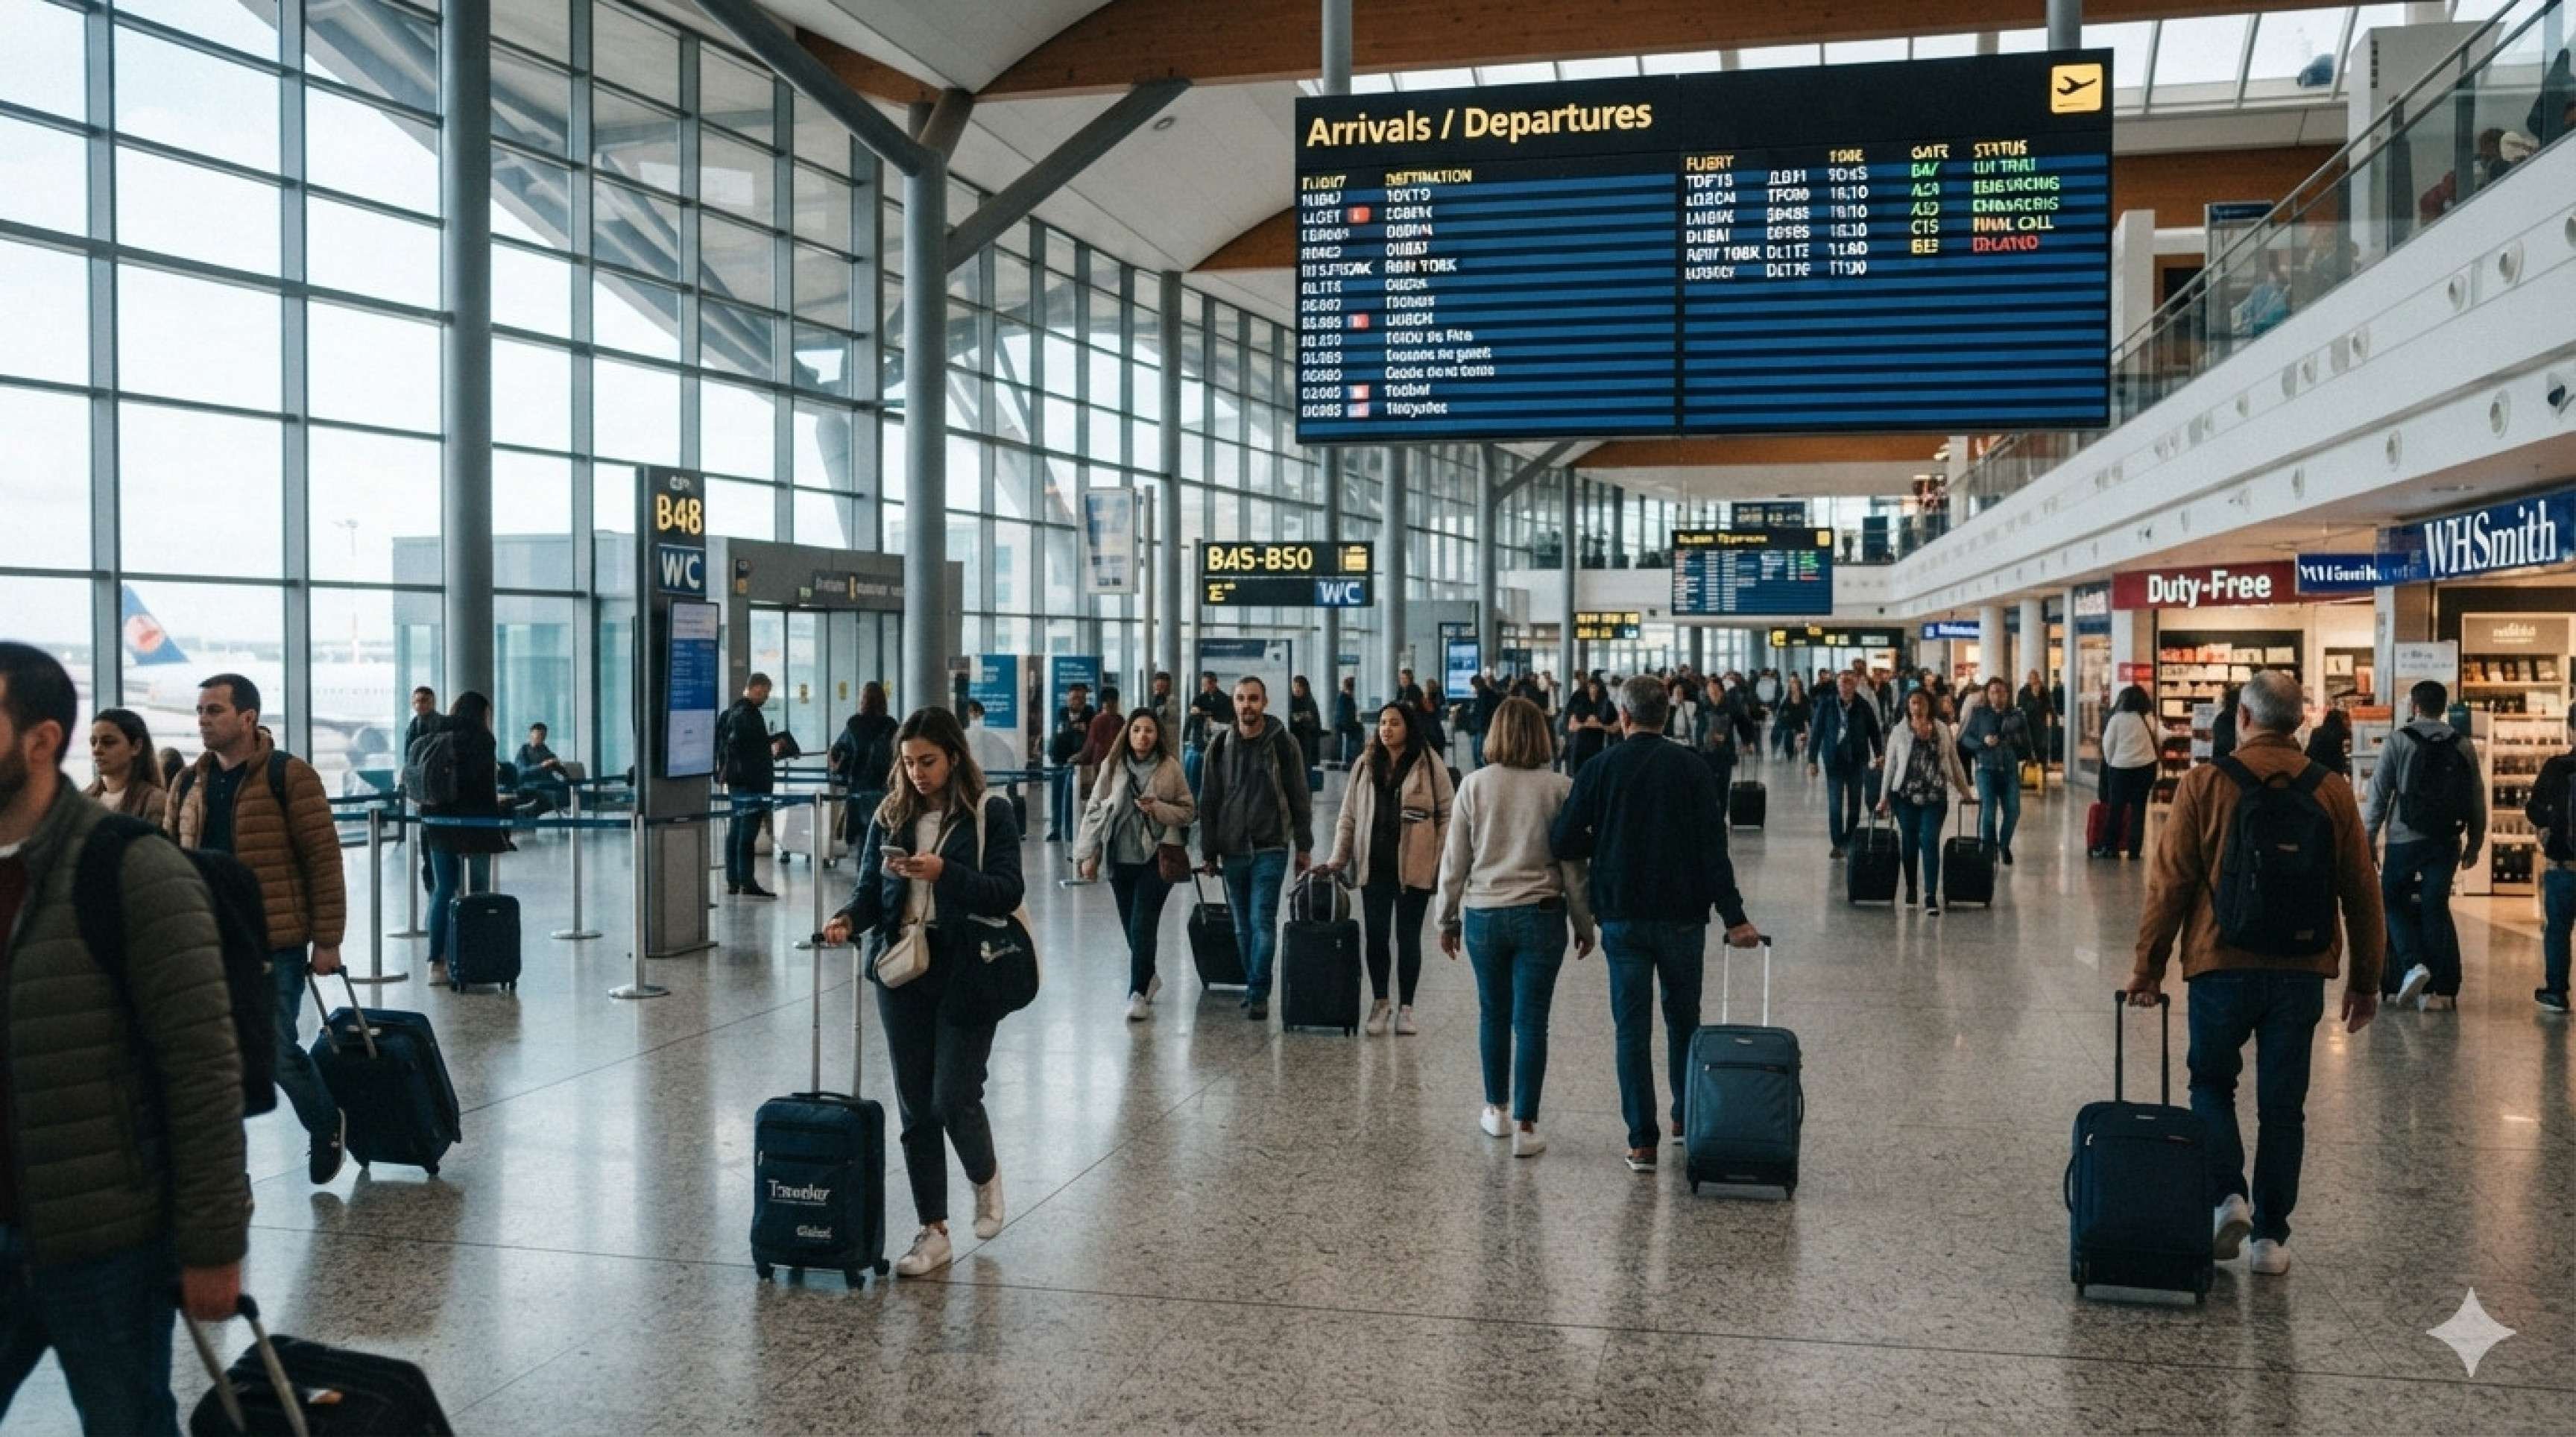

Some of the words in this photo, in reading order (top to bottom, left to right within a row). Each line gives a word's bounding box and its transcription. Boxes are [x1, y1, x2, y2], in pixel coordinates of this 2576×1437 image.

[1305, 110, 1432, 148] Arrivals
[1440, 108, 1455, 140] /
[1465, 103, 1653, 143] Departures
[656, 493, 703, 535] B48
[2424, 499, 2557, 578] WHSmith
[661, 550, 701, 589] WC
[2147, 570, 2272, 608] Duty-Free
[1319, 581, 1361, 604] WC
